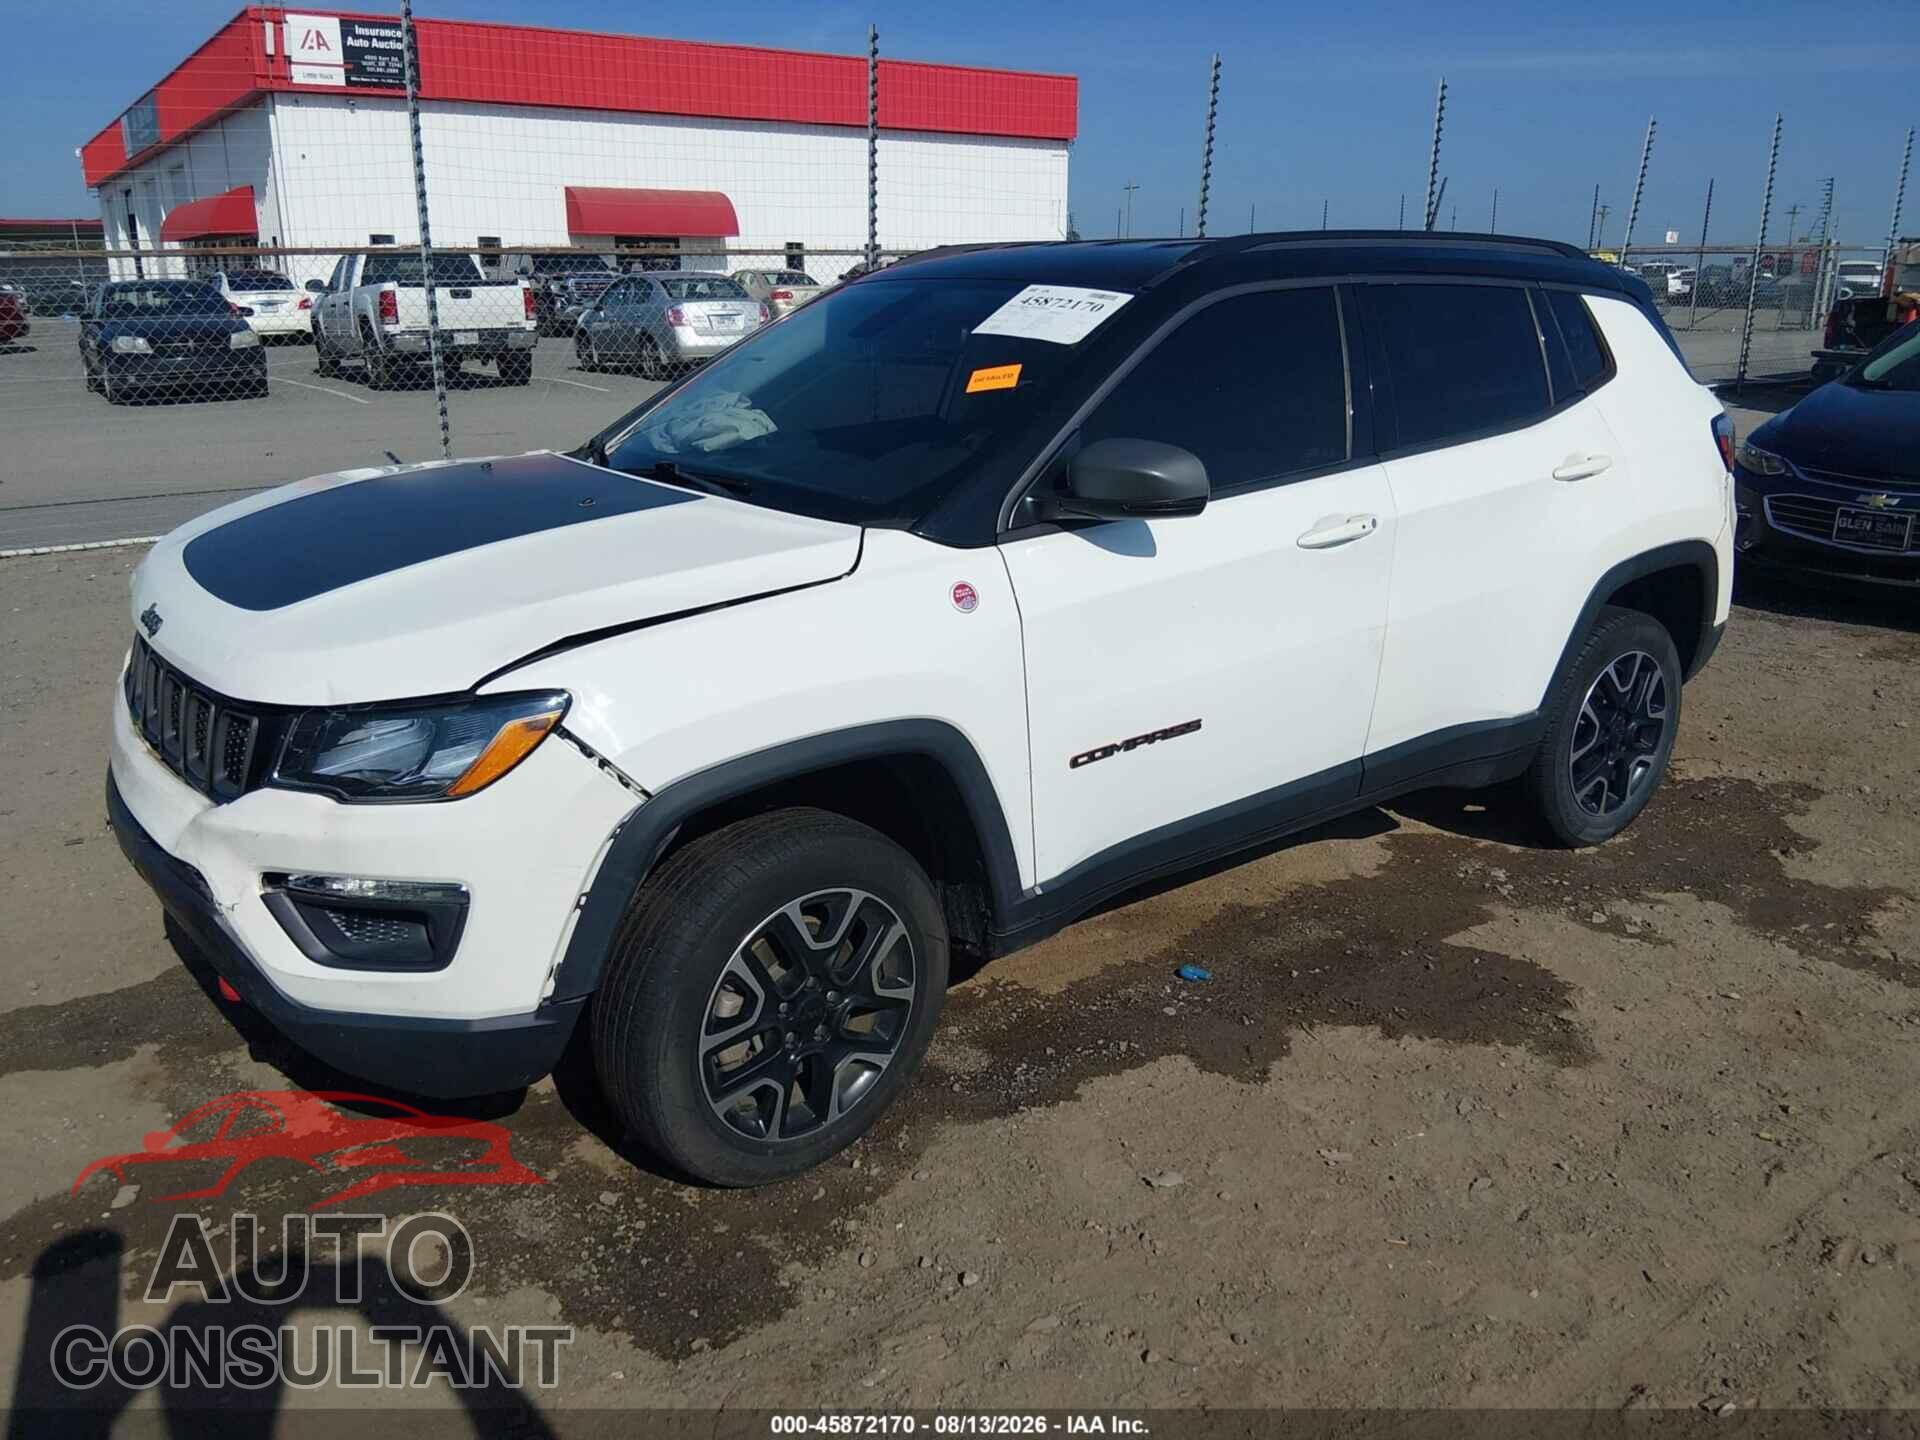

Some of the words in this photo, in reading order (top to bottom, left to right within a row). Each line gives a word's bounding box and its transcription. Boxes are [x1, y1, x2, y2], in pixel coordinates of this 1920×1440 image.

[354, 24, 402, 38] Insurance
[347, 36, 369, 48] Auto
[371, 38, 403, 50] Auctio
[1021, 296, 1105, 312] 45872170
[1070, 718, 1202, 769] COMPASS
